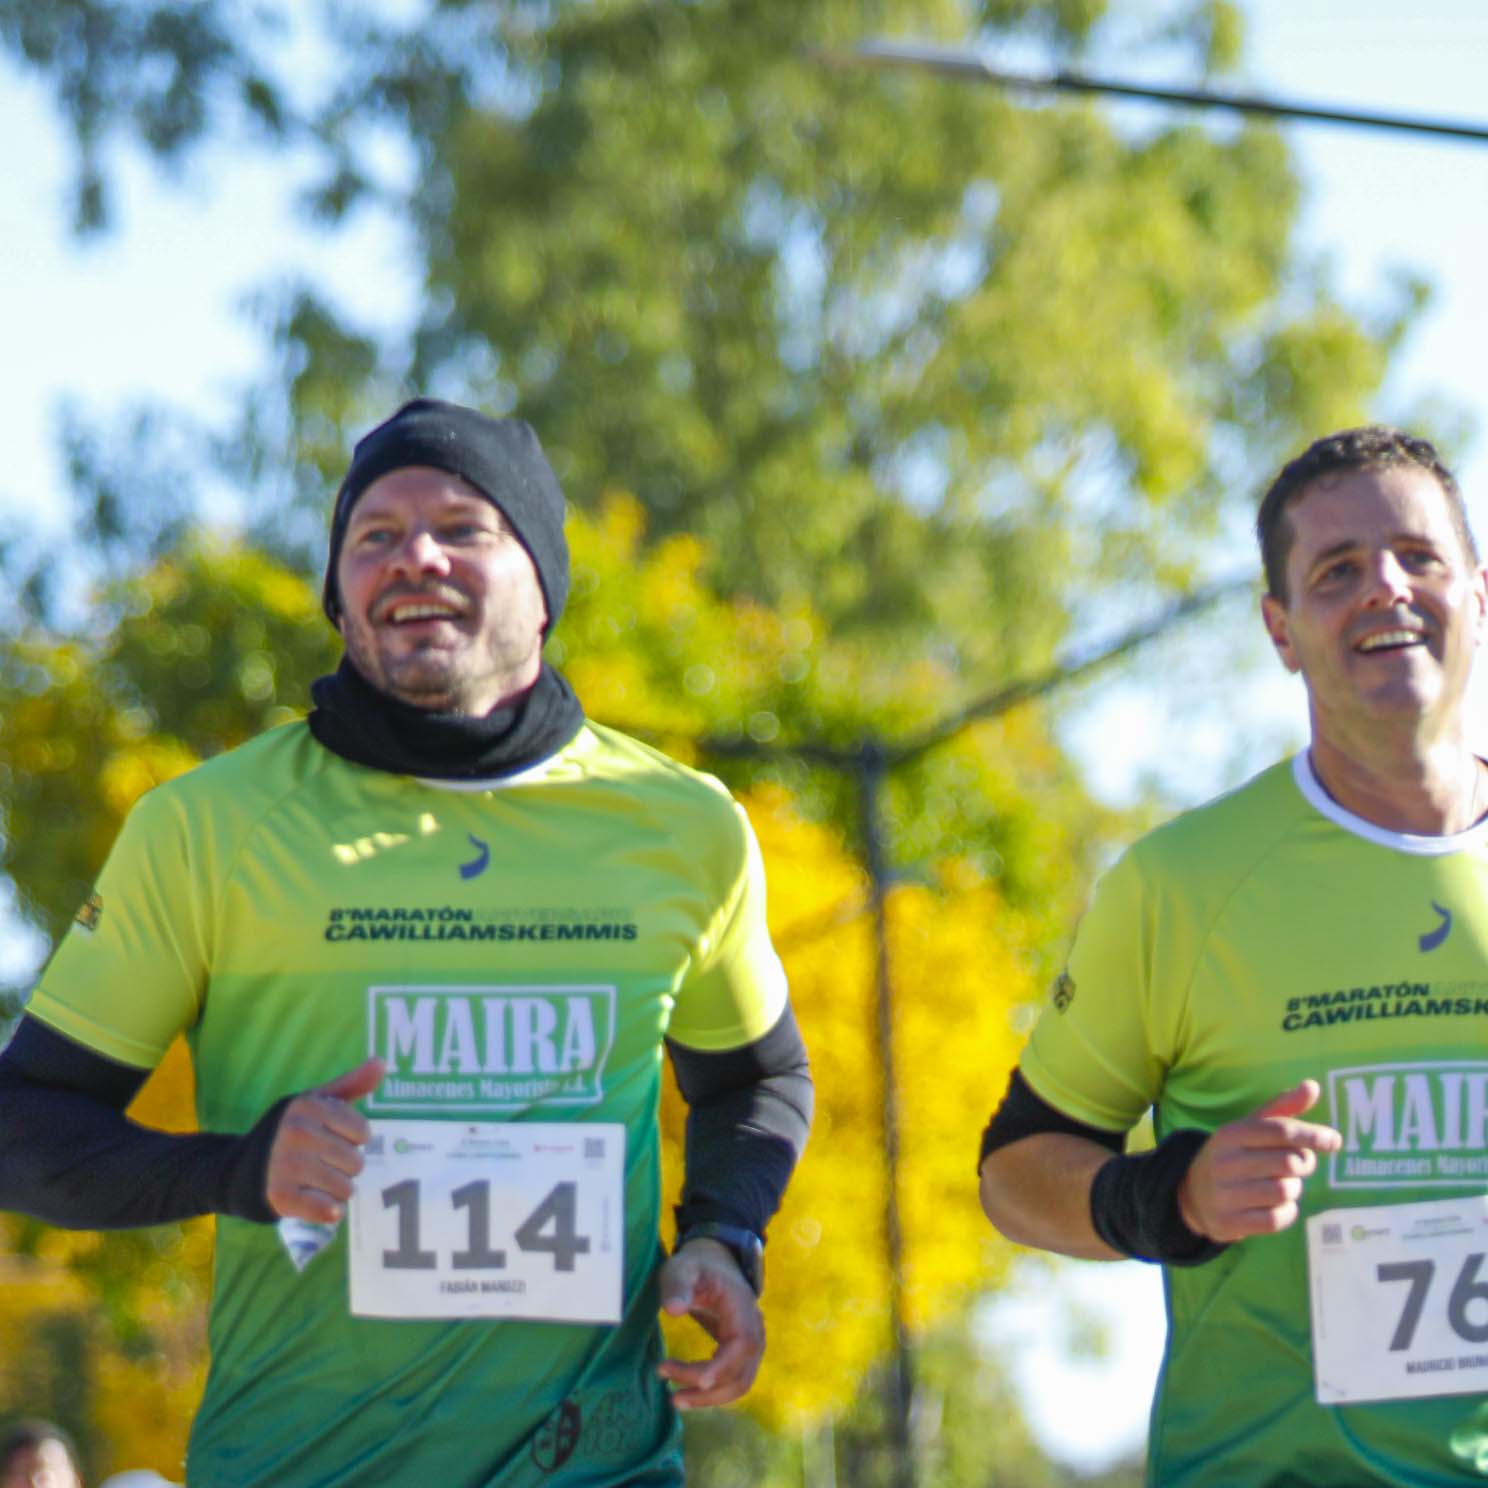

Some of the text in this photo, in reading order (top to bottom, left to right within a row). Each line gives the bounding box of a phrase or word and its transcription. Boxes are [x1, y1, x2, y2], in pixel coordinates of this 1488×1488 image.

[324, 923, 638, 942] CAWILLIAMSKEMMIS
[385, 997, 597, 1073] MAIRA
[384, 1078, 475, 1099] Almacenes
[1345, 1154, 1432, 1176] Almacenes
[381, 1178, 592, 1272] 114
